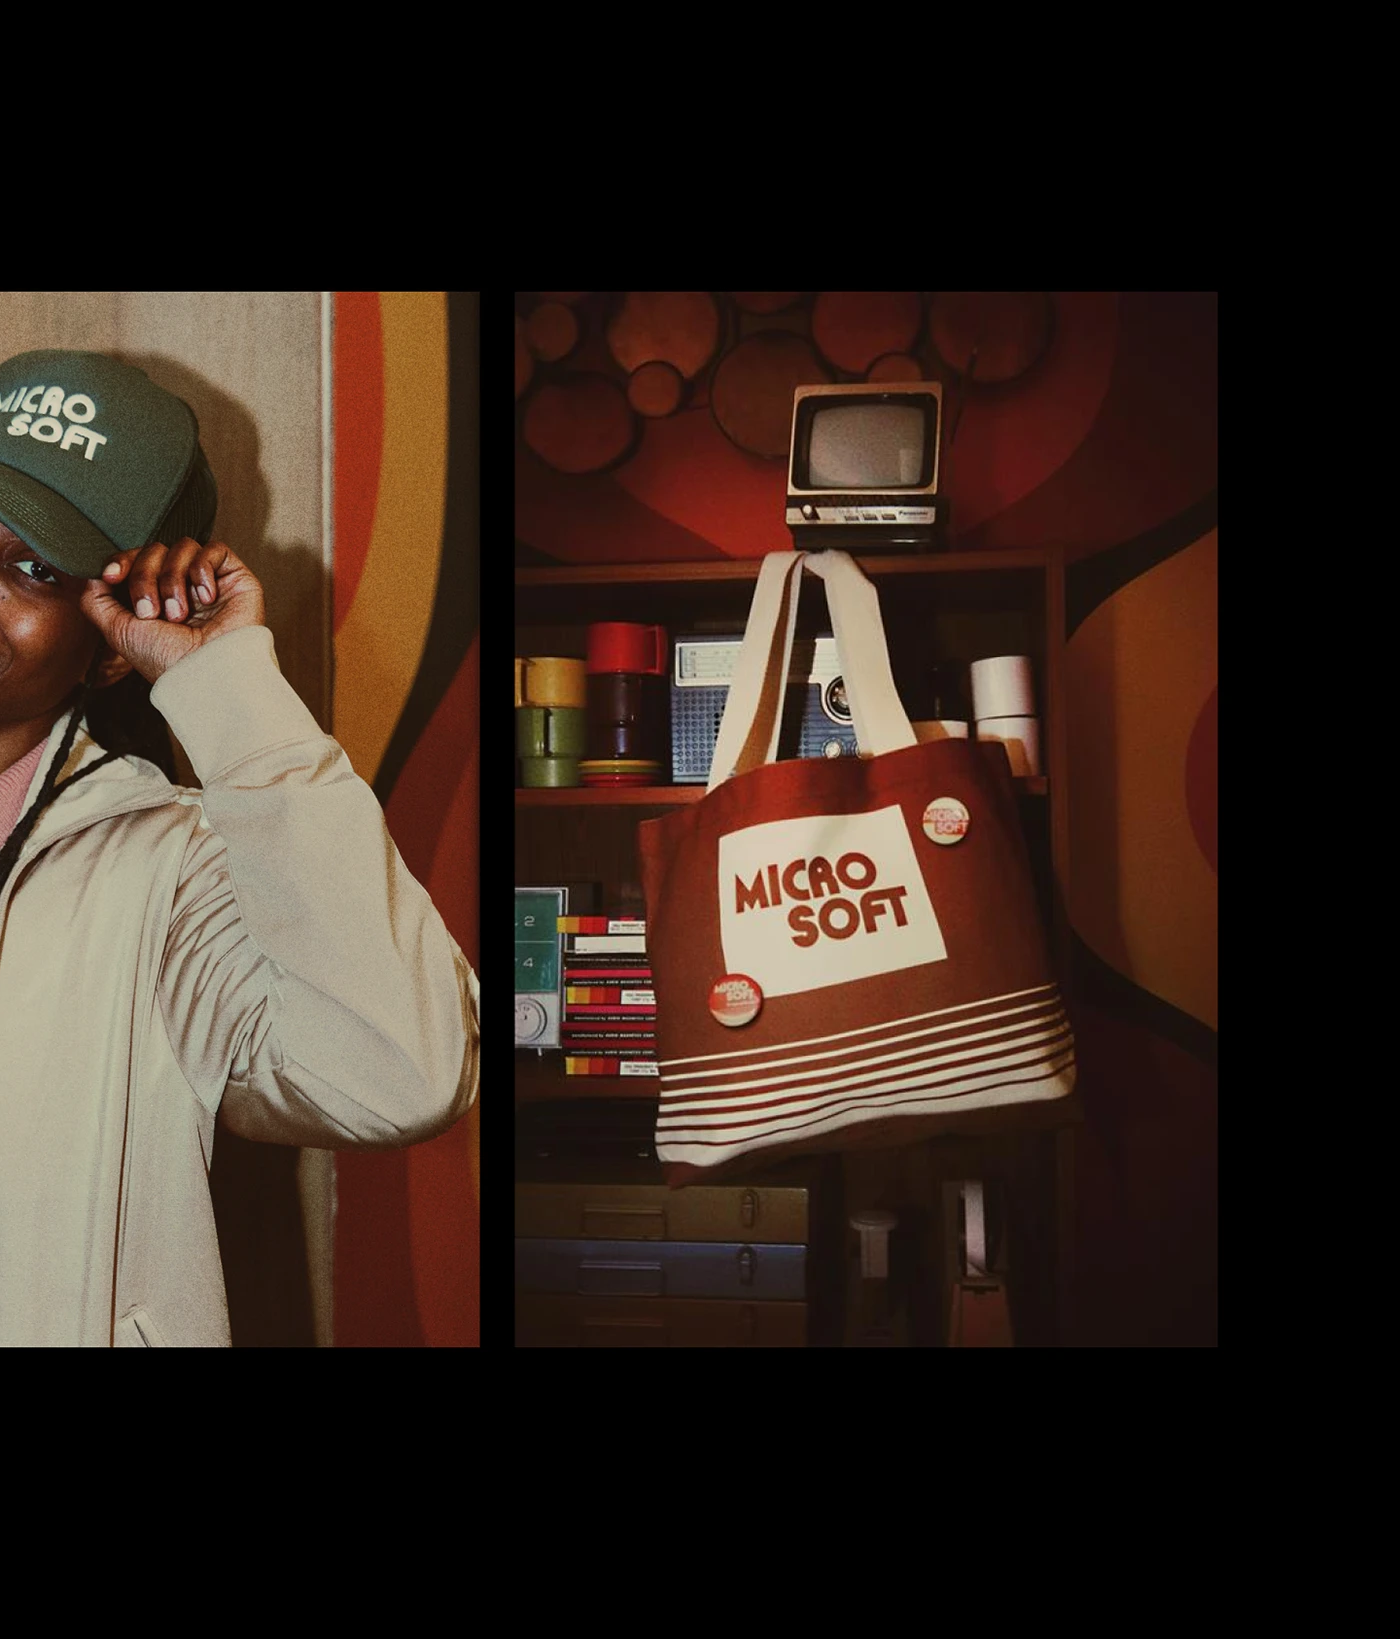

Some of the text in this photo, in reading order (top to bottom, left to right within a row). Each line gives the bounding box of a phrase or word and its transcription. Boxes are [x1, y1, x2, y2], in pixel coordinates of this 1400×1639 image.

[6, 412, 108, 461] SOFT
[734, 852, 877, 914] MICRO
[524, 915, 536, 927] 2
[787, 885, 909, 948] SOFT
[522, 957, 534, 968] 4
